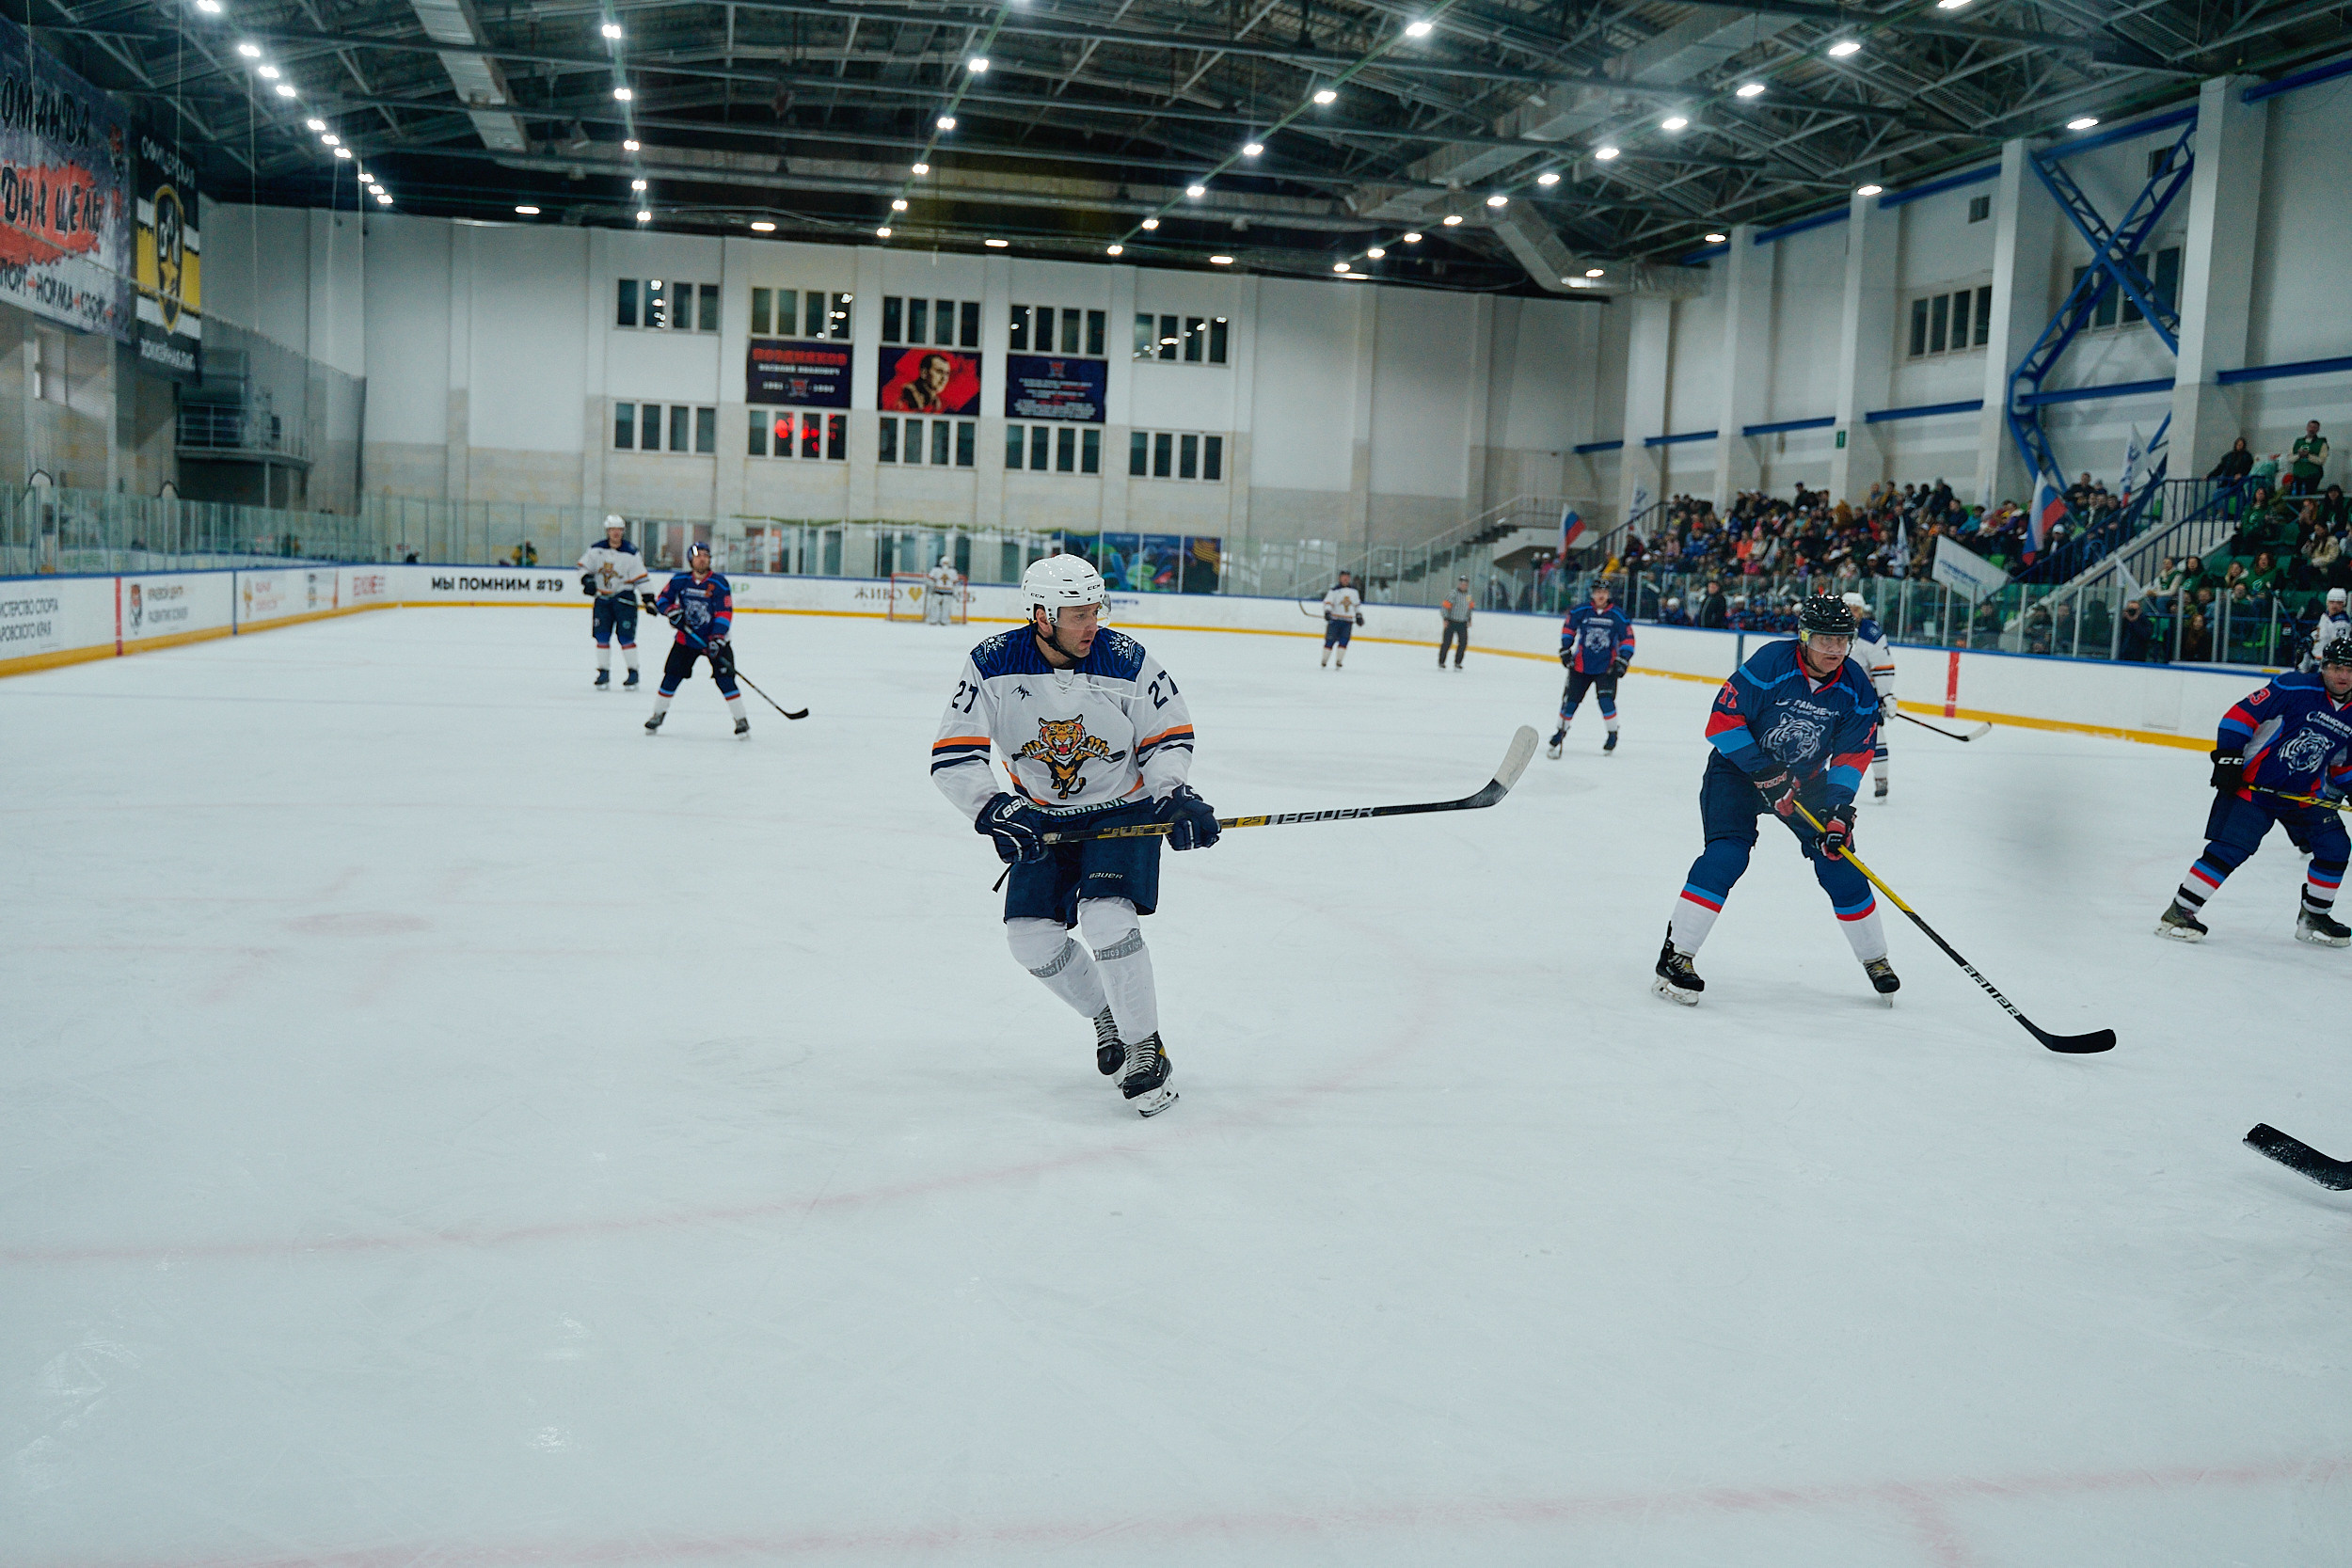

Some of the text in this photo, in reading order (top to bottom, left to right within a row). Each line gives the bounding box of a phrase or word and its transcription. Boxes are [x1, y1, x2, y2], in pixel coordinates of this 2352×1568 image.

[1, 74, 90, 149] ОМАНДА
[0, 166, 47, 228] ДНА
[431, 577, 564, 592] МЫ ПОМНИМ #19
[951, 679, 979, 714] 27
[1148, 669, 1179, 710] 27
[1718, 680, 1740, 709] 77
[2217, 756, 2245, 765] CC
[1002, 797, 1027, 819] BAU
[1280, 806, 1375, 825] BAUER
[1089, 871, 1124, 879] BAUER
[1962, 963, 2022, 1018] BAUER
